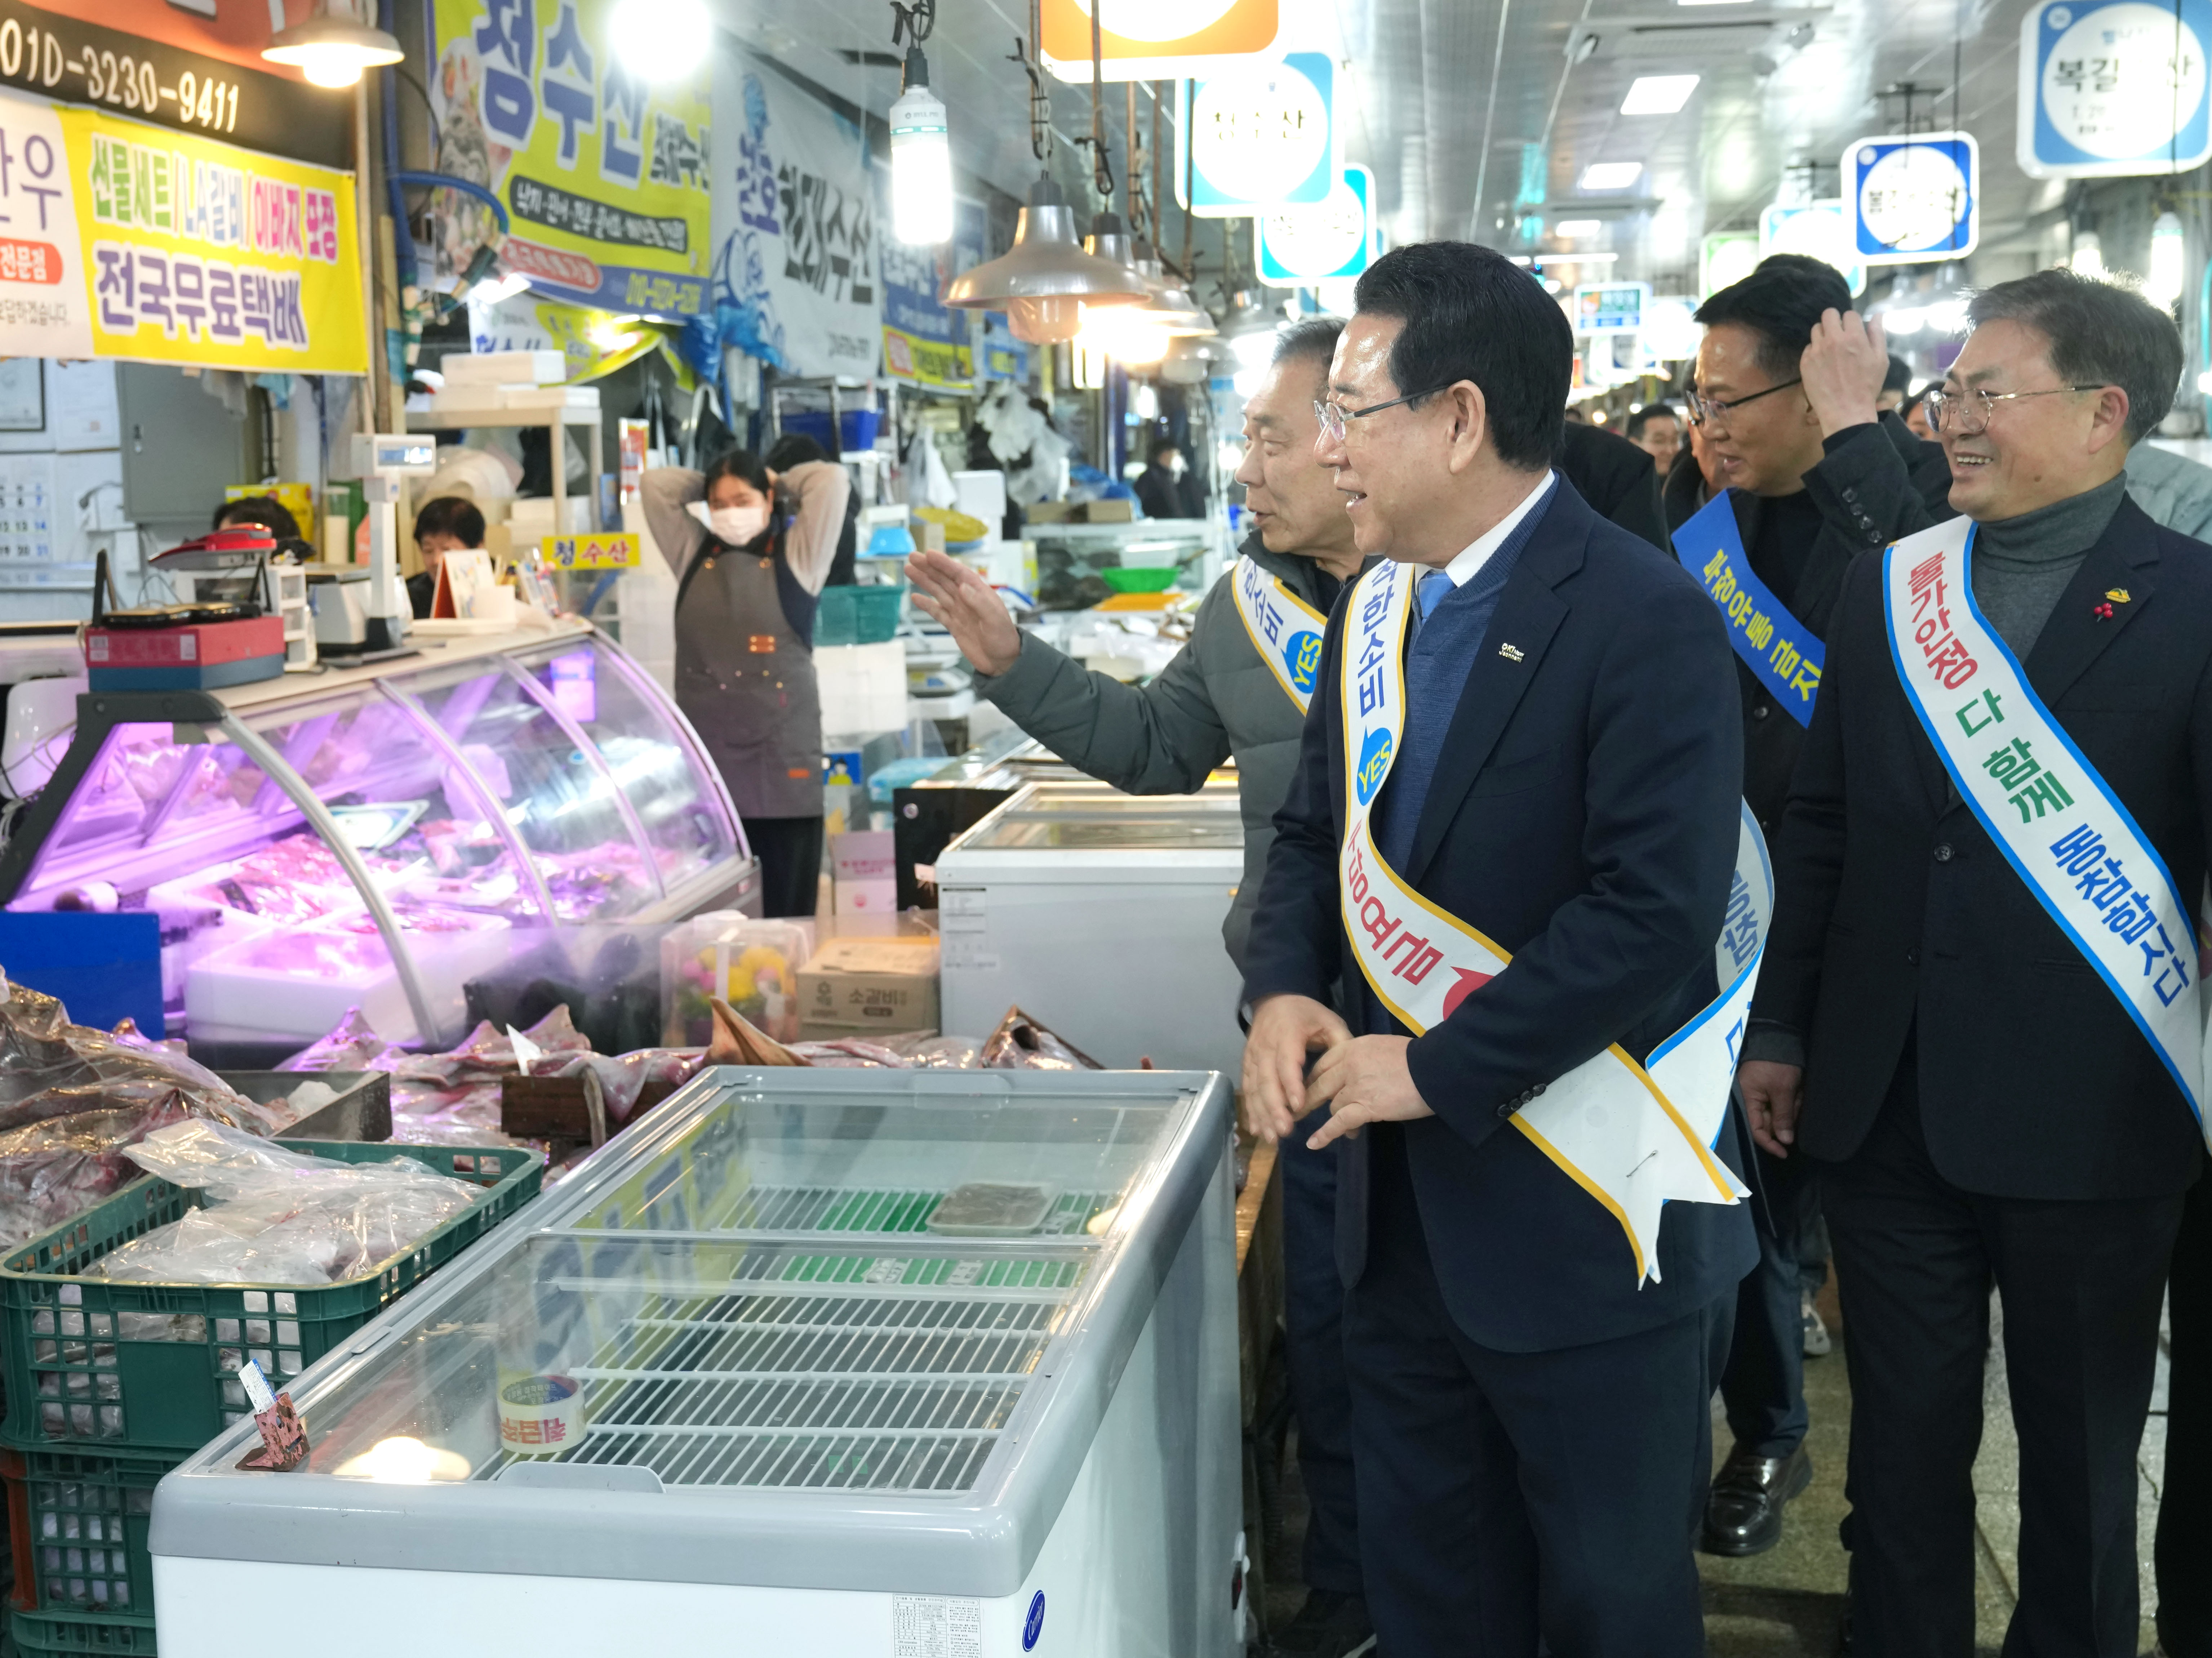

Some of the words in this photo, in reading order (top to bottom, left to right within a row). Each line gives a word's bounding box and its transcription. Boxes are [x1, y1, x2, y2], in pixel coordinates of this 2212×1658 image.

[1, 18, 239, 133] 010-3230-9411
[97, 249, 307, 344] 전국무료택배
[554, 540, 630, 566] 청수산
[1293, 634, 1322, 686] YES
[1702, 548, 1775, 651] 부정유통
[1769, 638, 1822, 702] 금지
[1358, 739, 1392, 795] YES
[1906, 549, 1979, 691] 물가안정
[1955, 688, 2006, 739] 다
[1981, 736, 2076, 825] 함께
[2048, 822, 2191, 1009] 동참합시다
[1028, 1601, 1044, 1640] Carrier
